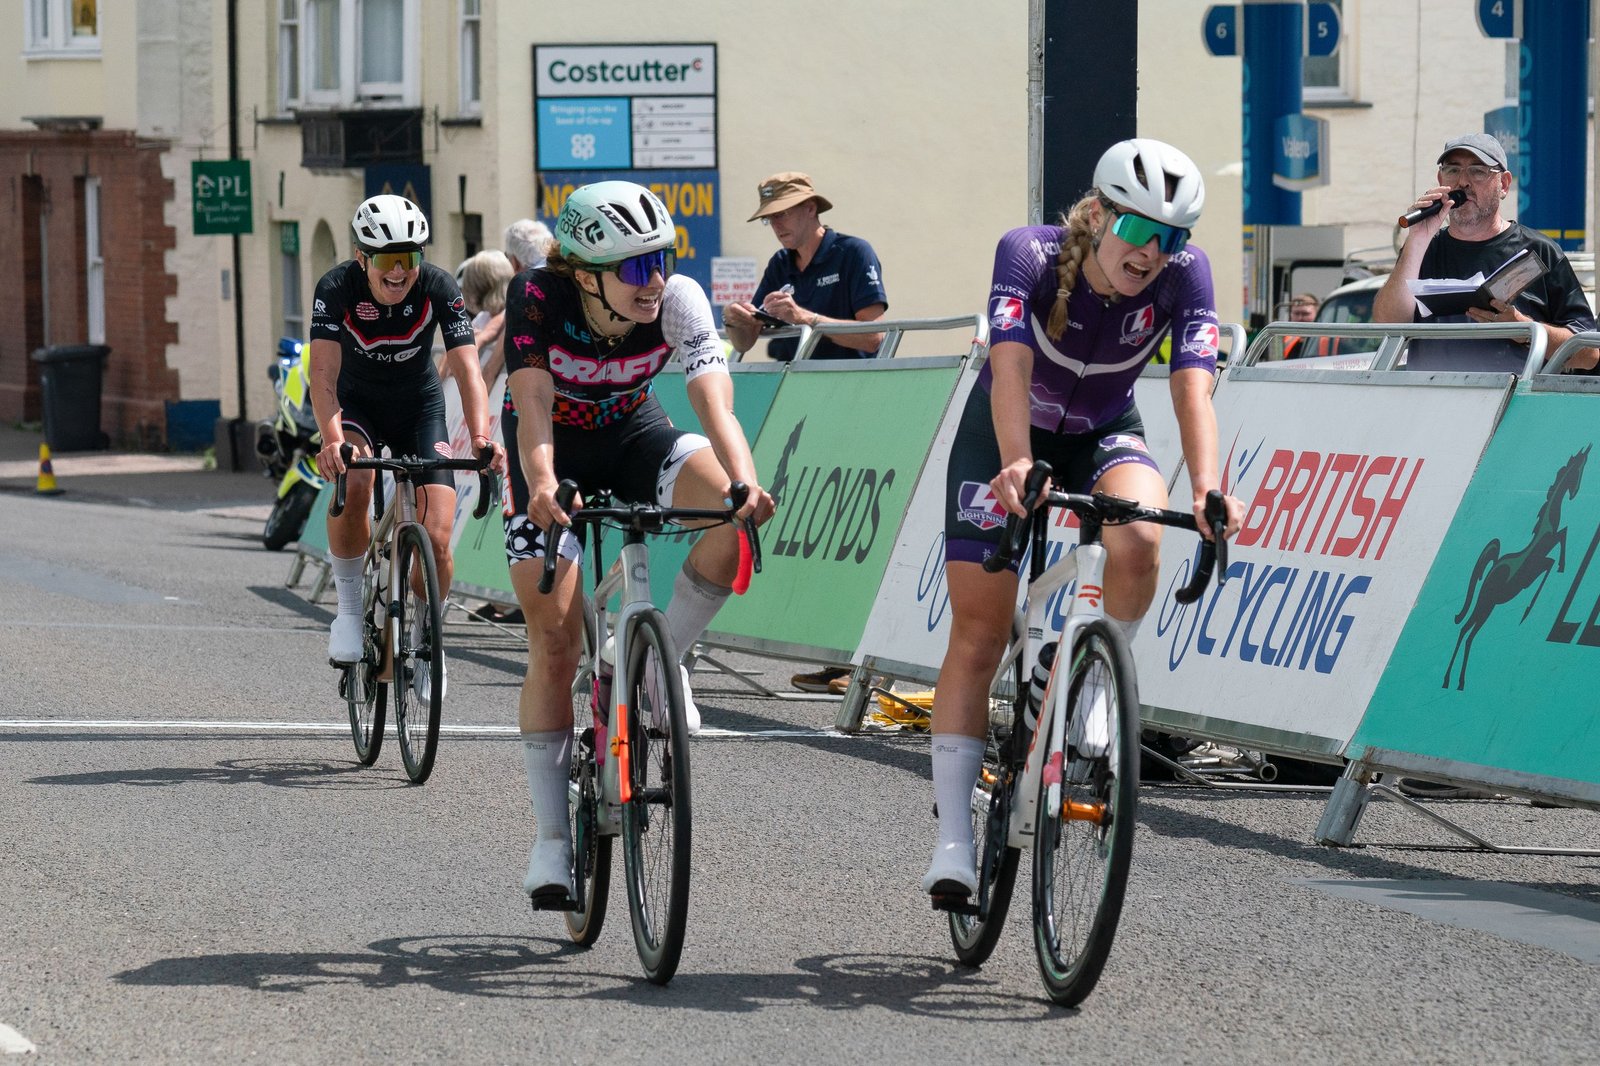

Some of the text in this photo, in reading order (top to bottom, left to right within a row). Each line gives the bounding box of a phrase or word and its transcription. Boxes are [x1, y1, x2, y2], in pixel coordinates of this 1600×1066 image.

[1491, 0, 1504, 17] 4
[1216, 23, 1227, 38] 6
[1318, 22, 1328, 37] 5
[548, 60, 690, 83] Costcutter
[195, 174, 248, 198] EPL
[655, 183, 713, 217] EVON
[596, 204, 633, 237] LAZER
[642, 234, 661, 243] LAZER
[448, 320, 470, 330] LUCKY
[548, 346, 668, 384] DRAFT
[685, 355, 726, 375] KASK
[772, 466, 896, 564] LLOYDS
[1234, 449, 1425, 561] BRITISH
[958, 510, 1008, 528] LIGHTNING
[1196, 560, 1373, 675] CYCLING
